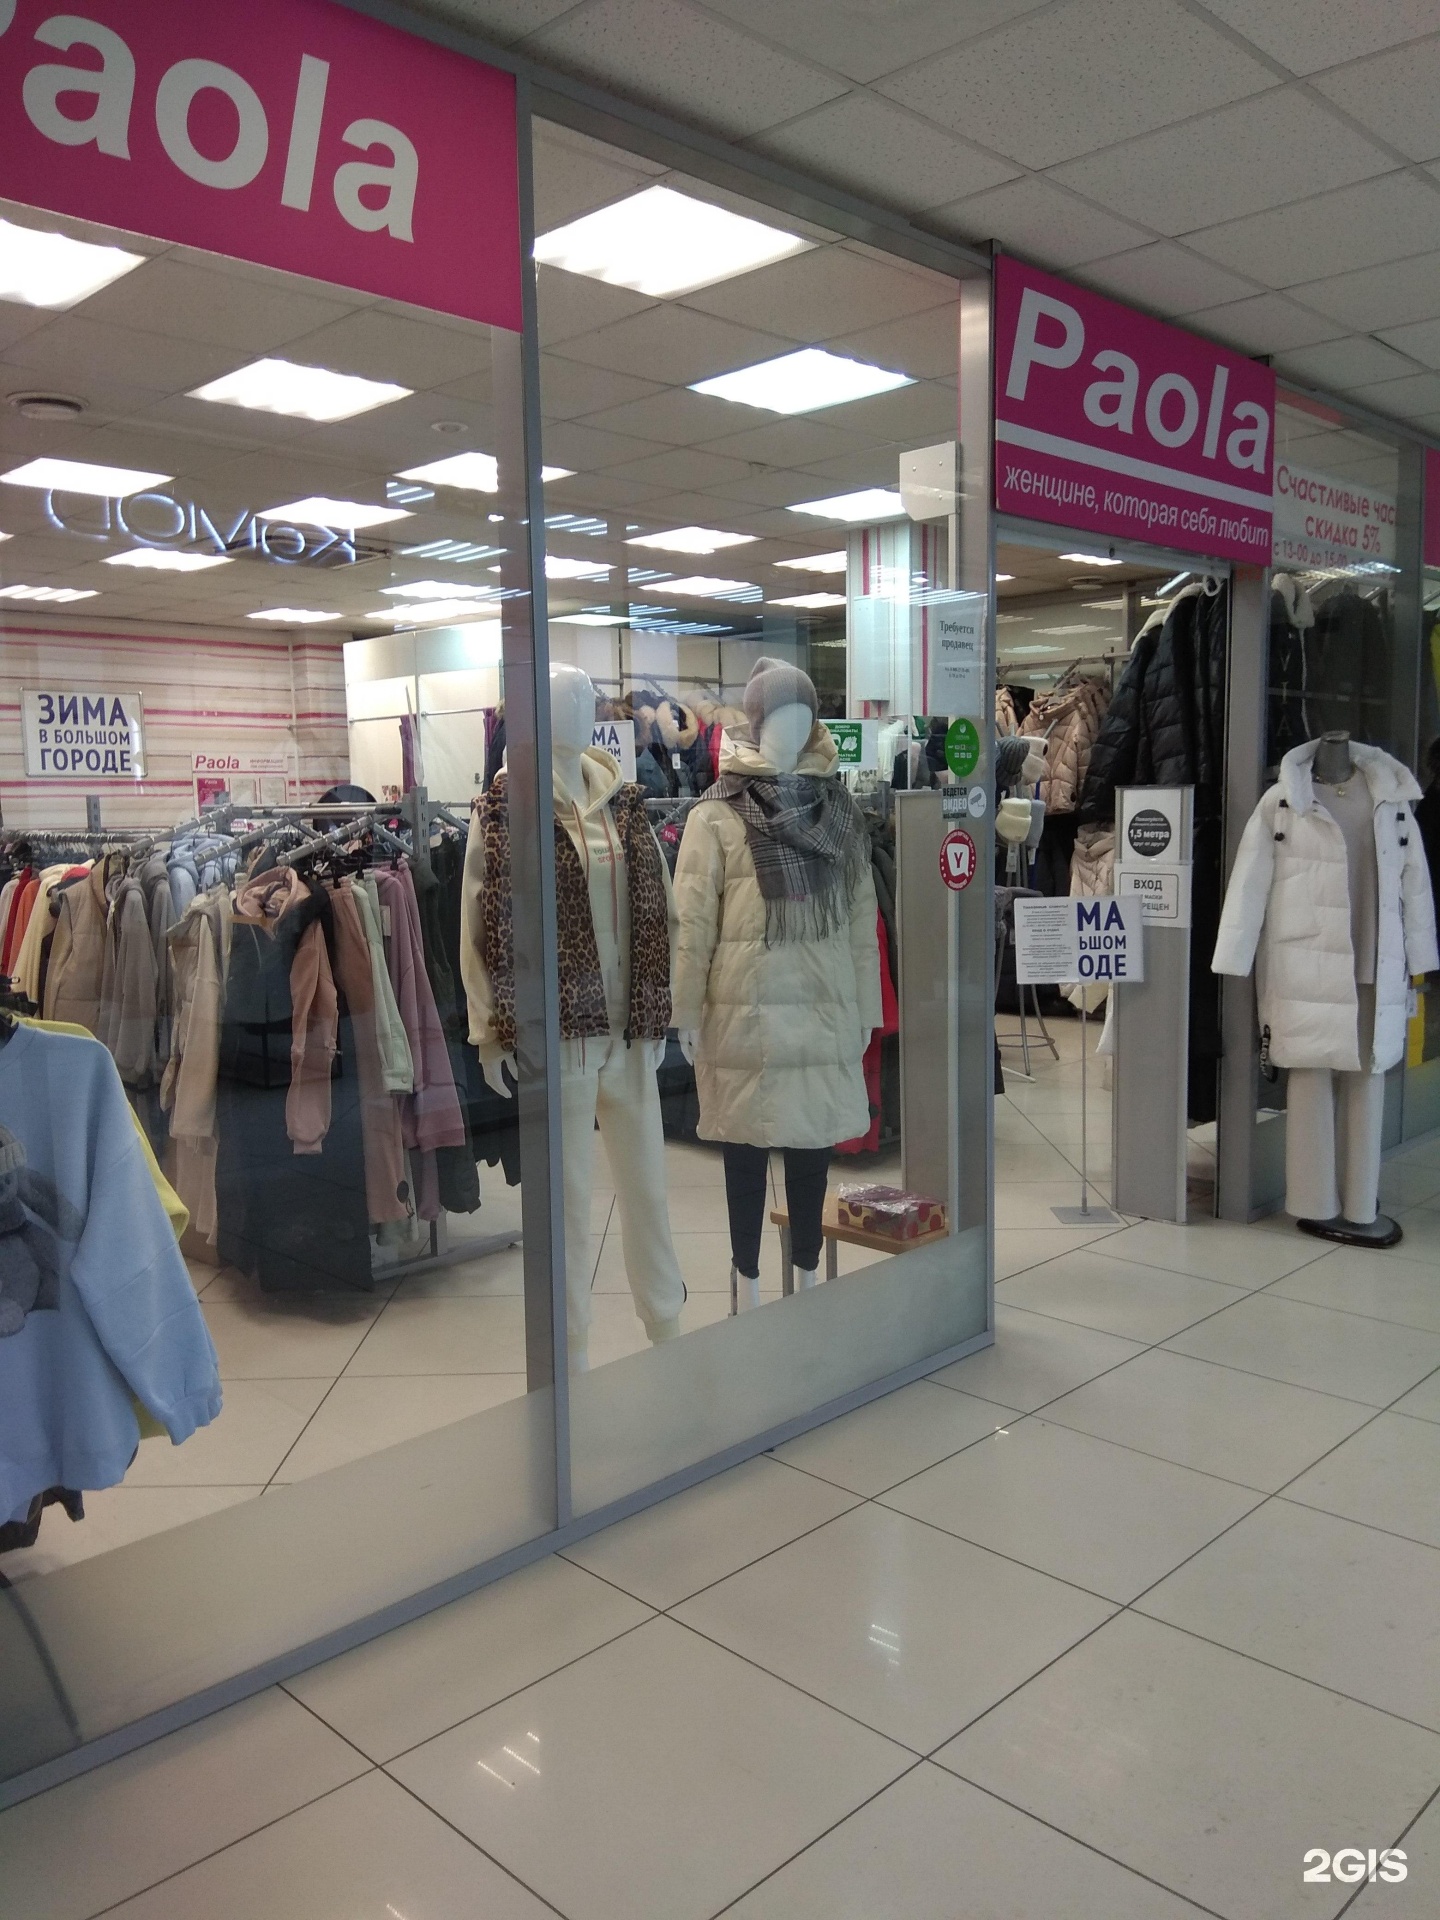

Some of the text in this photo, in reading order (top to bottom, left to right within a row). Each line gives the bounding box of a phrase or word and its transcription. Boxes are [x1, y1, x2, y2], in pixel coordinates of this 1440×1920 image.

[0, 0, 419, 243] aola
[1005, 287, 1270, 474] Paola
[1277, 465, 1398, 526] Счастливые час
[1003, 465, 1269, 547] женщине, которая себя любит
[1305, 515, 1381, 553] скидка 5%
[1283, 540, 1308, 562] 13-00
[1310, 553, 1322, 566] до
[940, 620, 975, 635] Требуется
[941, 639, 974, 652] продавец
[38, 694, 128, 727] ЗИМА
[39, 729, 130, 745] В БОЛЬШОМ
[592, 725, 620, 746] МА
[40, 748, 131, 774] ГОРОДЕ
[195, 755, 240, 769] Paola
[943, 787, 968, 797] ВЕДЕТСЯ
[942, 797, 968, 812] ВИДЕО
[1129, 829, 1170, 840] 1,5 метра
[954, 852, 963, 868] Y
[1133, 879, 1163, 891] ВХОД
[1141, 902, 1170, 911] РЕЩЕН
[1077, 901, 1126, 932] МА
[1080, 935, 1126, 950] ЬШОМ
[1078, 954, 1127, 980] ОДЕ
